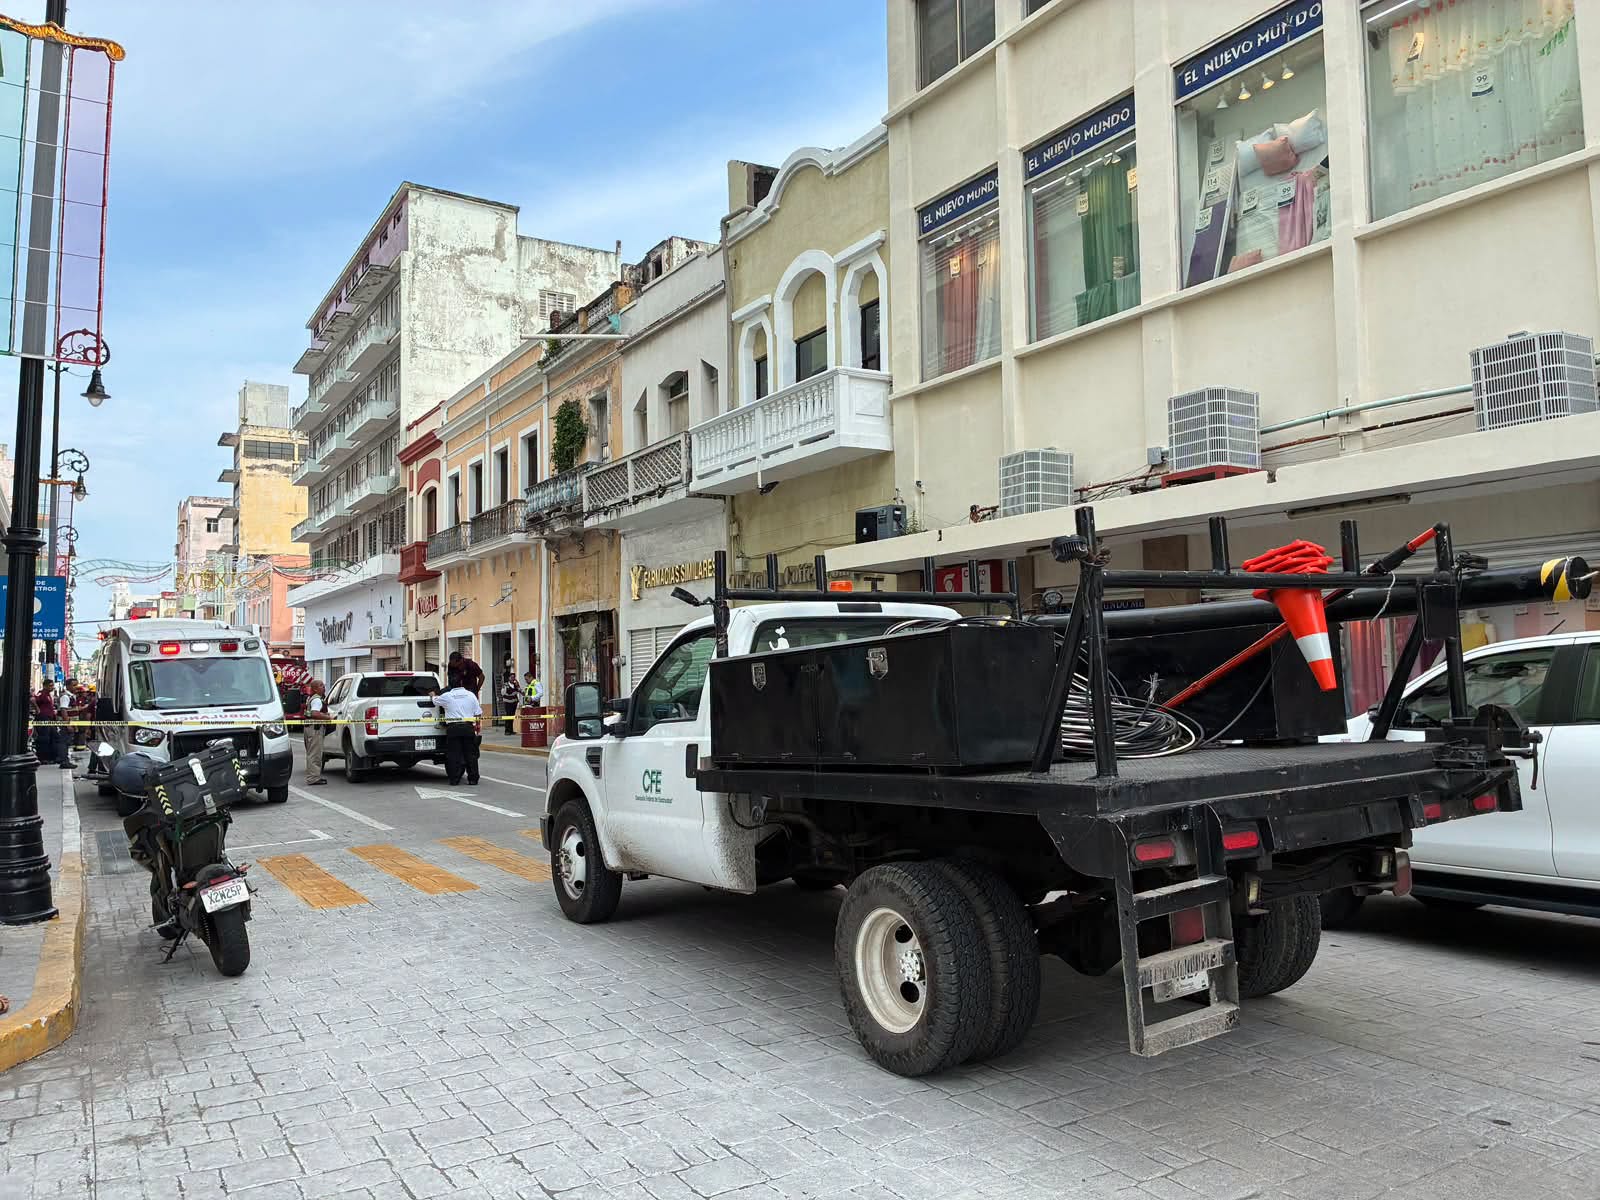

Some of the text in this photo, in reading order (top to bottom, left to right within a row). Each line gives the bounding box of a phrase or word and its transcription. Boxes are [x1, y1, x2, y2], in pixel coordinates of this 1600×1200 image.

[1184, 3, 1321, 86] EL NUEVO MUNDO
[1028, 108, 1130, 172] EL NUEVO MUNDO
[923, 213, 933, 227] EL
[935, 195, 964, 220] NUEVO
[644, 564, 680, 588] FARMACIAS
[642, 769, 662, 793] CFE
